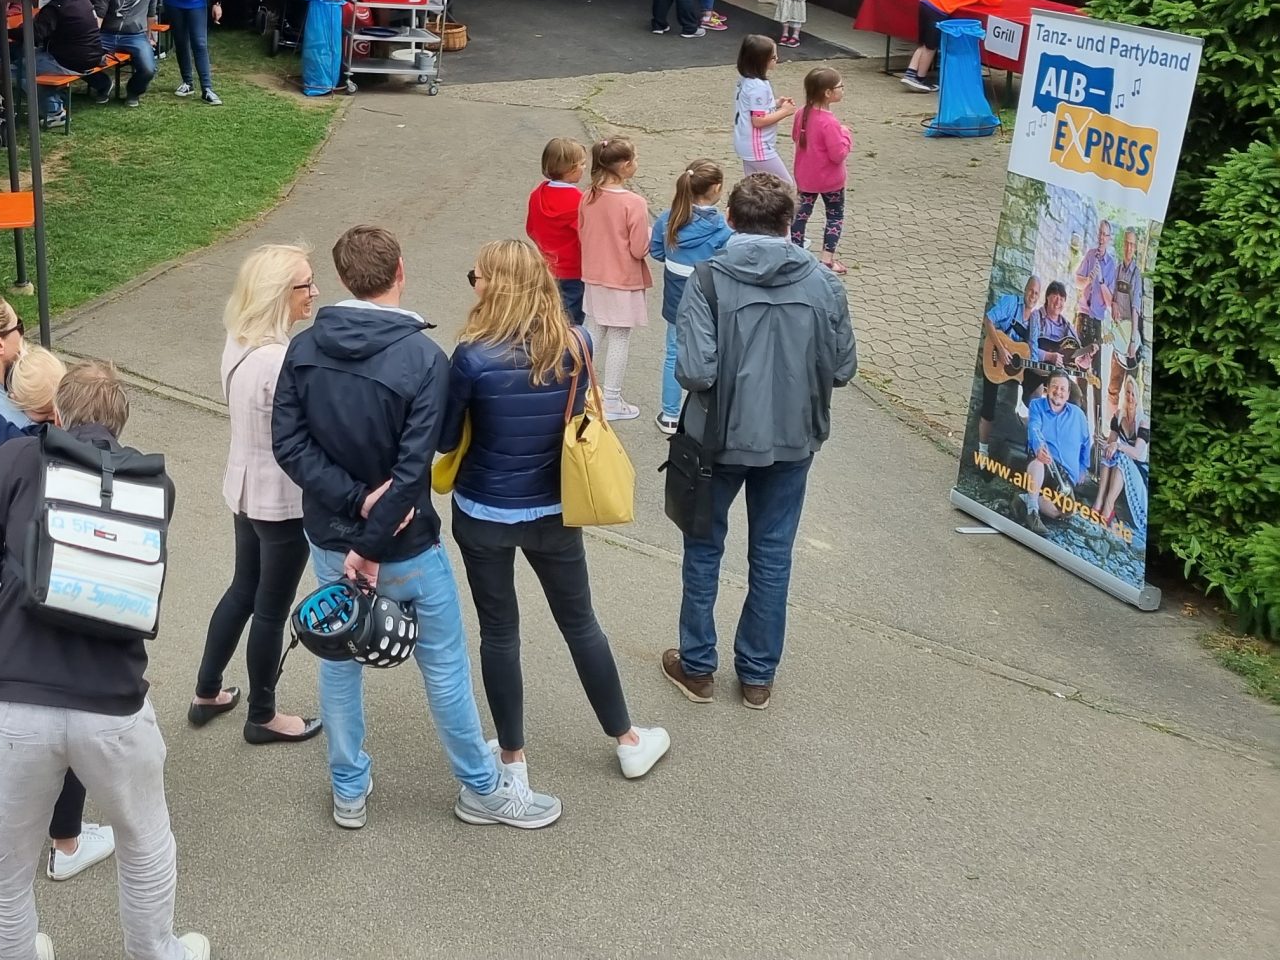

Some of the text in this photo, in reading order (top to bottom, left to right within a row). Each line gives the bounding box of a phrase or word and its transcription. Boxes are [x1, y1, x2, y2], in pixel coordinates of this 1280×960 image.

[992, 25, 1016, 44] Grill
[1036, 23, 1191, 71] Tanz- und Partyband
[1054, 112, 1153, 176] EXPRESS
